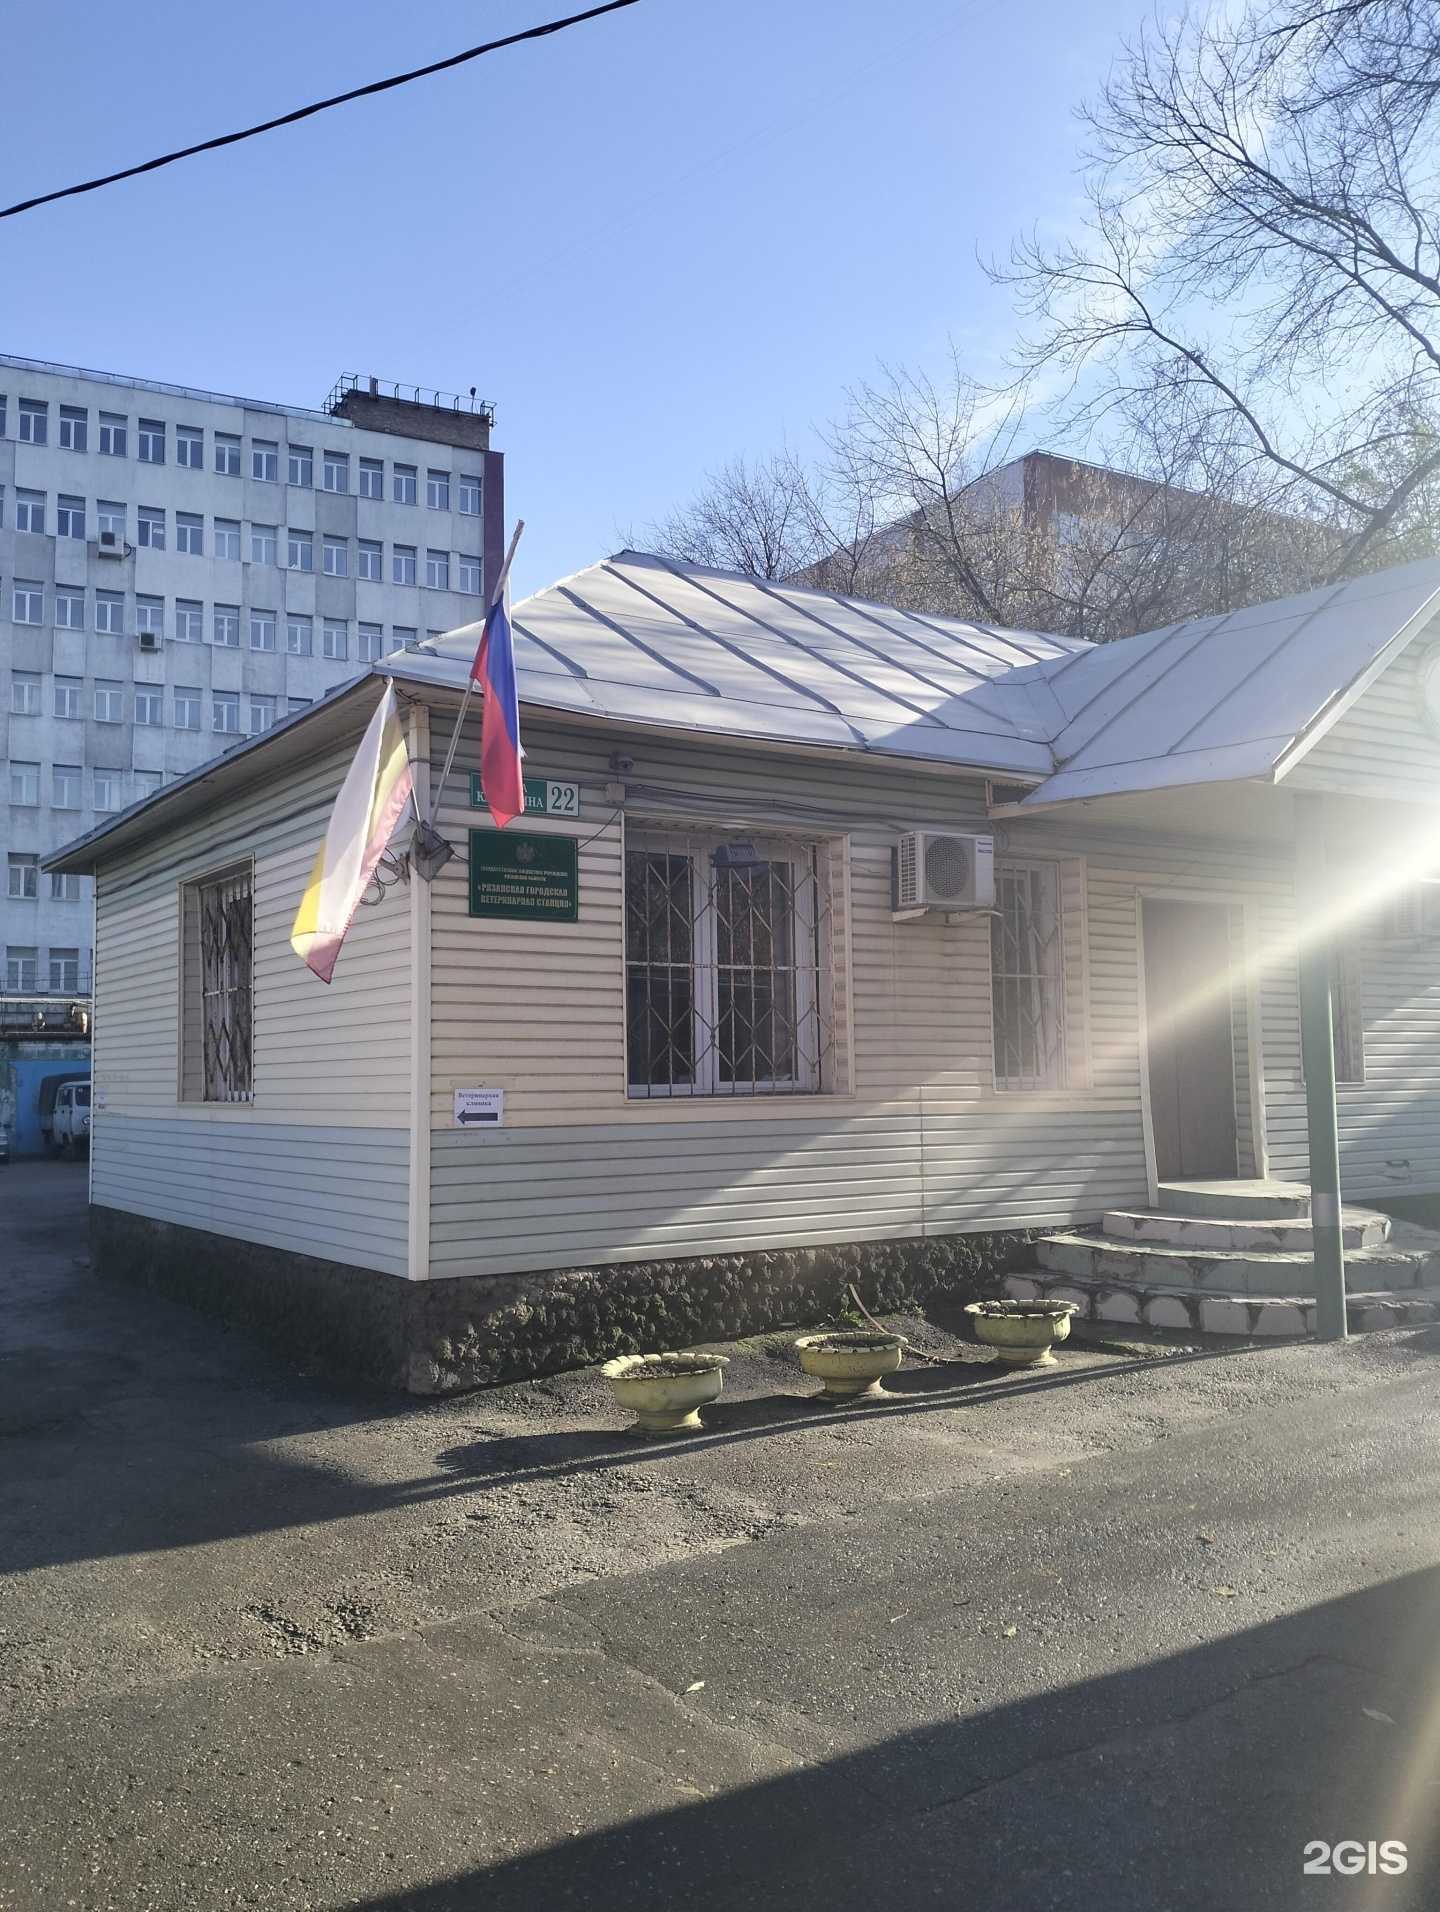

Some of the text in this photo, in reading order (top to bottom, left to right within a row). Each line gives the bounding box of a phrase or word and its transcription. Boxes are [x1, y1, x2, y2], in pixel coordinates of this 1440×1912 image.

[551, 786, 574, 811] 22
[526, 886, 568, 897] ГОРОДСКАЯ
[480, 894, 535, 906] ВЕТЕРИНАРНАЯ
